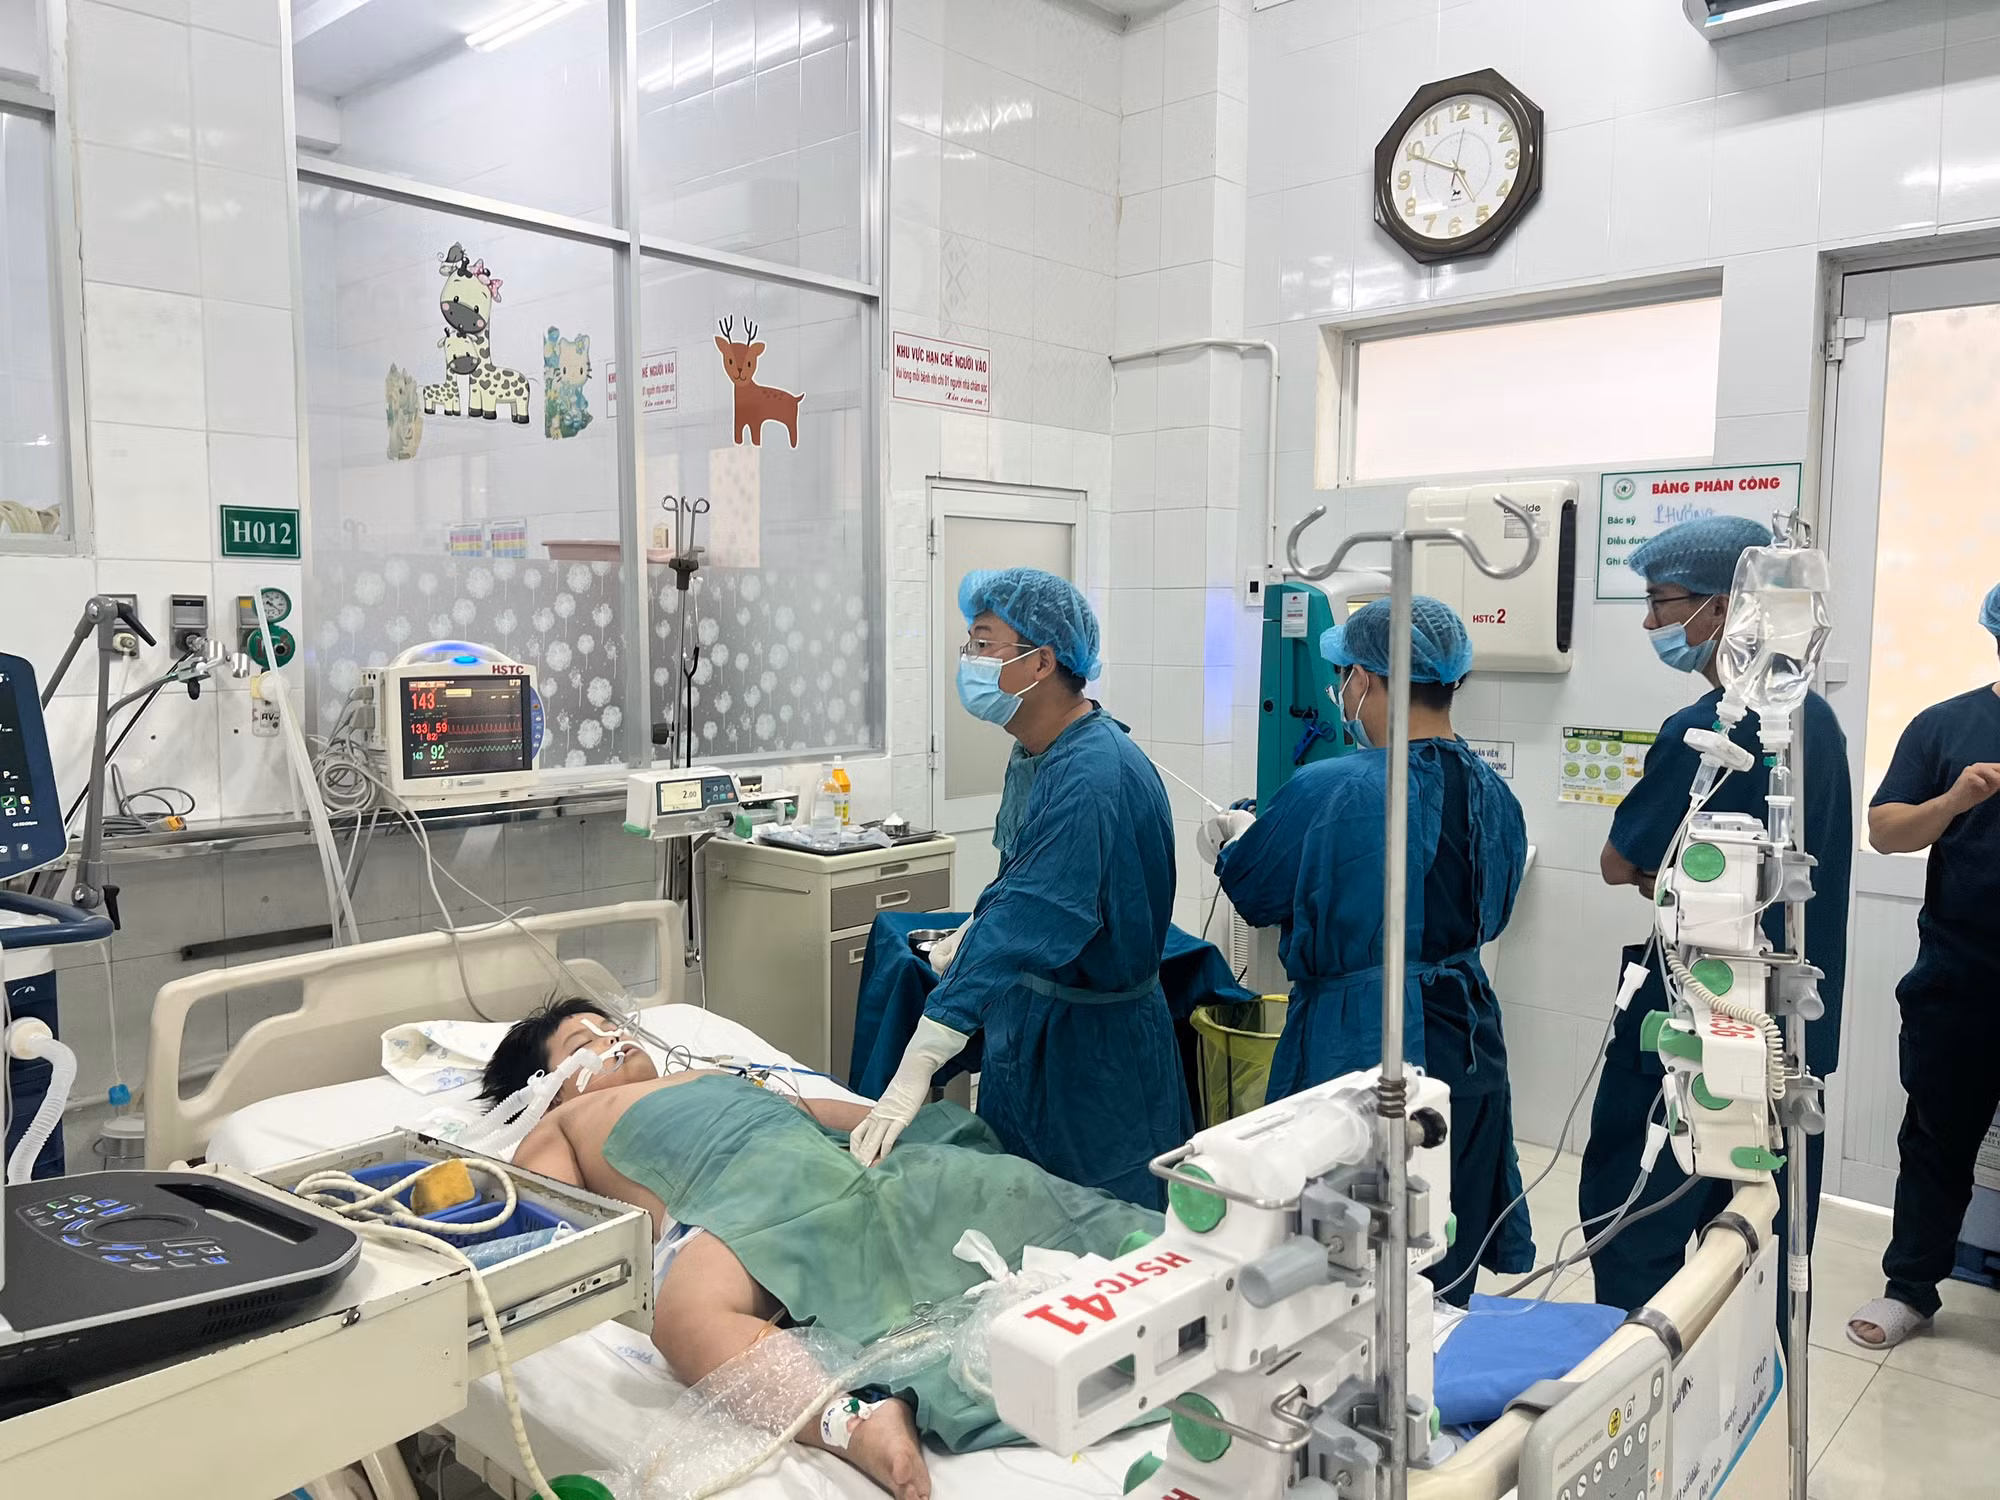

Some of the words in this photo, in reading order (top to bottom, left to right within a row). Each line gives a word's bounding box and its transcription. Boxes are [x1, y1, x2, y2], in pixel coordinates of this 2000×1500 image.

[1449, 101, 1470, 123] 12
[1482, 105, 1489, 124] 1
[1424, 115, 1438, 136] 11
[1498, 122, 1513, 143] 2
[1504, 149, 1519, 169] 3
[1398, 170, 1411, 190] 9
[1496, 179, 1510, 198] 4
[1405, 198, 1416, 217] 8
[1476, 205, 1489, 225] 5
[1423, 214, 1437, 233] 7
[1448, 217, 1462, 236] 6
[896, 344, 910, 359] KHU
[911, 346, 925, 363] VỰC
[926, 350, 939, 366] HẠN
[1652, 480, 1690, 495] BẢNG
[1694, 478, 1734, 493] PHÂN
[1738, 476, 1781, 491] CÔNG
[1607, 516, 1624, 525] Bác
[232, 520, 292, 545] H012
[1605, 557, 1621, 566] Ghi
[1472, 614, 1495, 623] HSTC
[1496, 608, 1506, 624] 2
[491, 665, 524, 675] HSTC
[411, 692, 435, 710] 143
[435, 721, 448, 733] 59
[430, 744, 446, 760] 92
